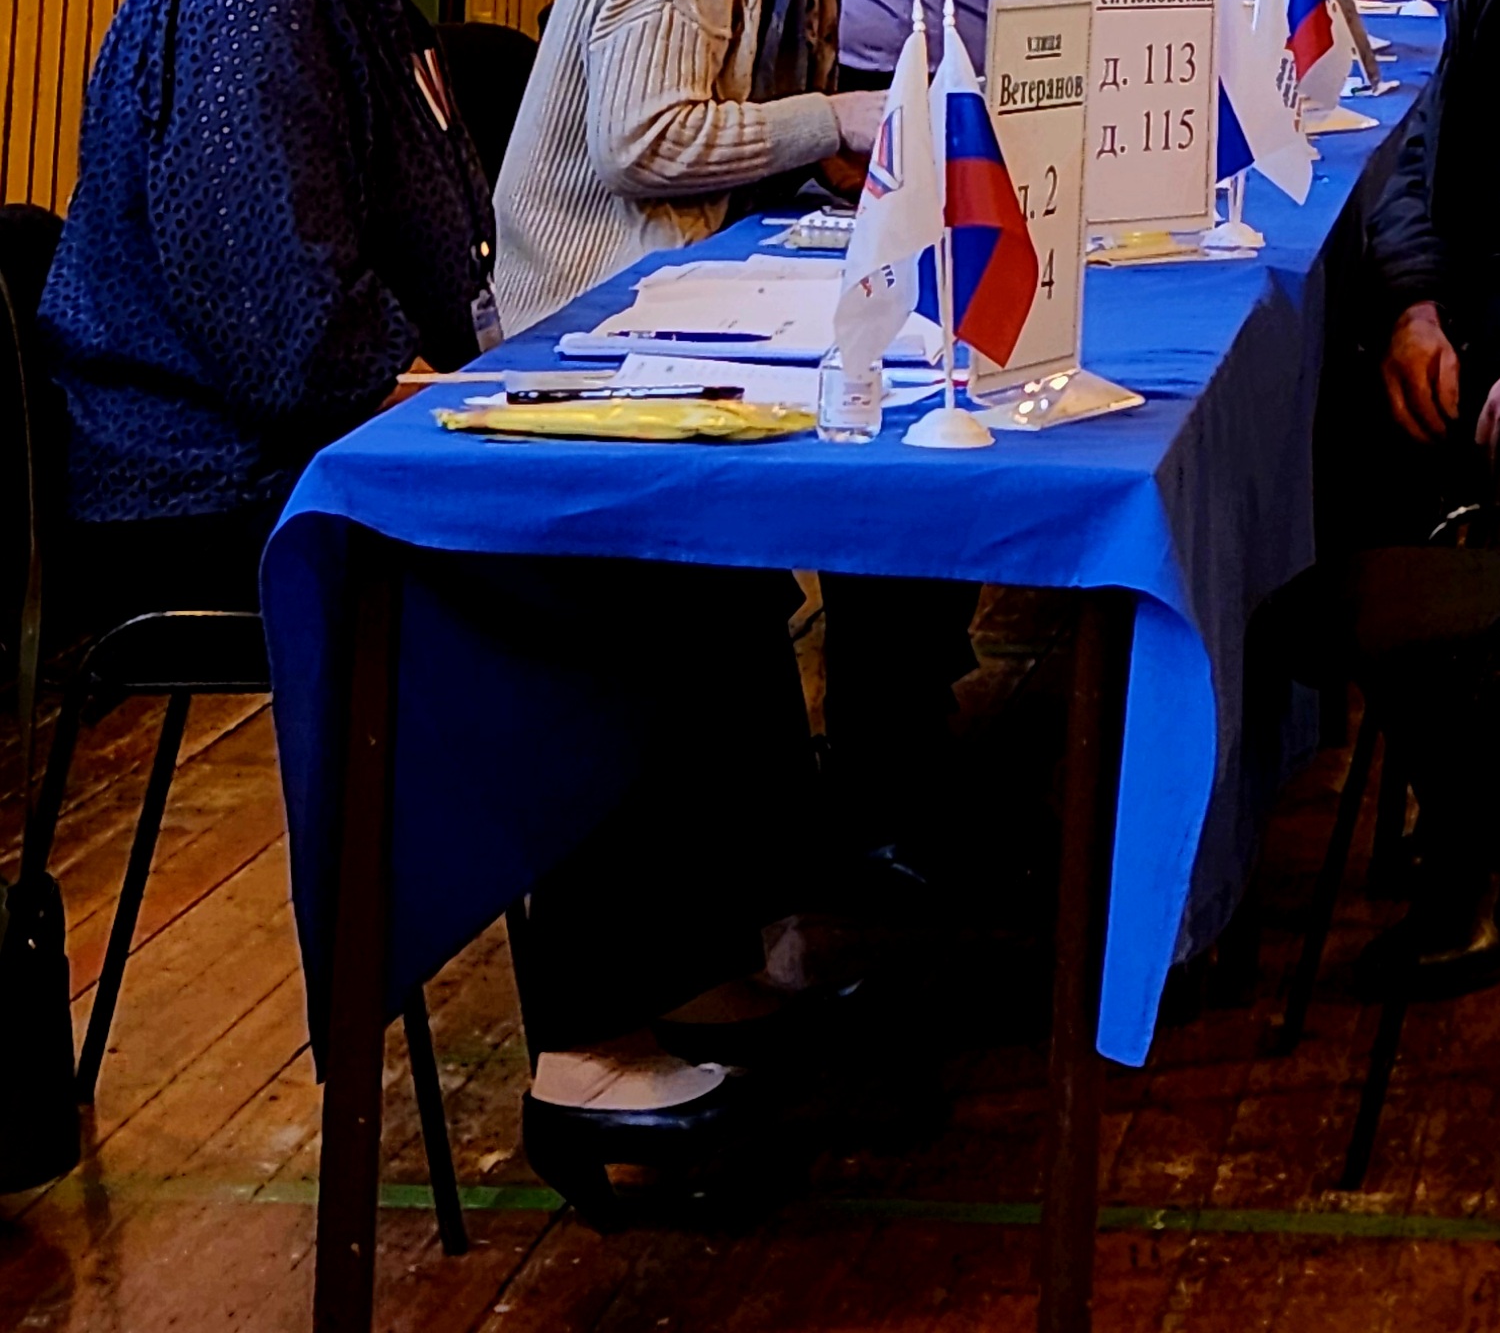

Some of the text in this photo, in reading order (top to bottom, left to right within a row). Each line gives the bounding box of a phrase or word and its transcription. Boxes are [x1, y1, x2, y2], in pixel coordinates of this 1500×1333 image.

[1000, 73, 1083, 108] Ветеранов
[1100, 42, 1196, 92] д. 113
[1096, 109, 1195, 159] д. 115
[1042, 165, 1057, 217] 2
[1041, 248, 1055, 300] 4
